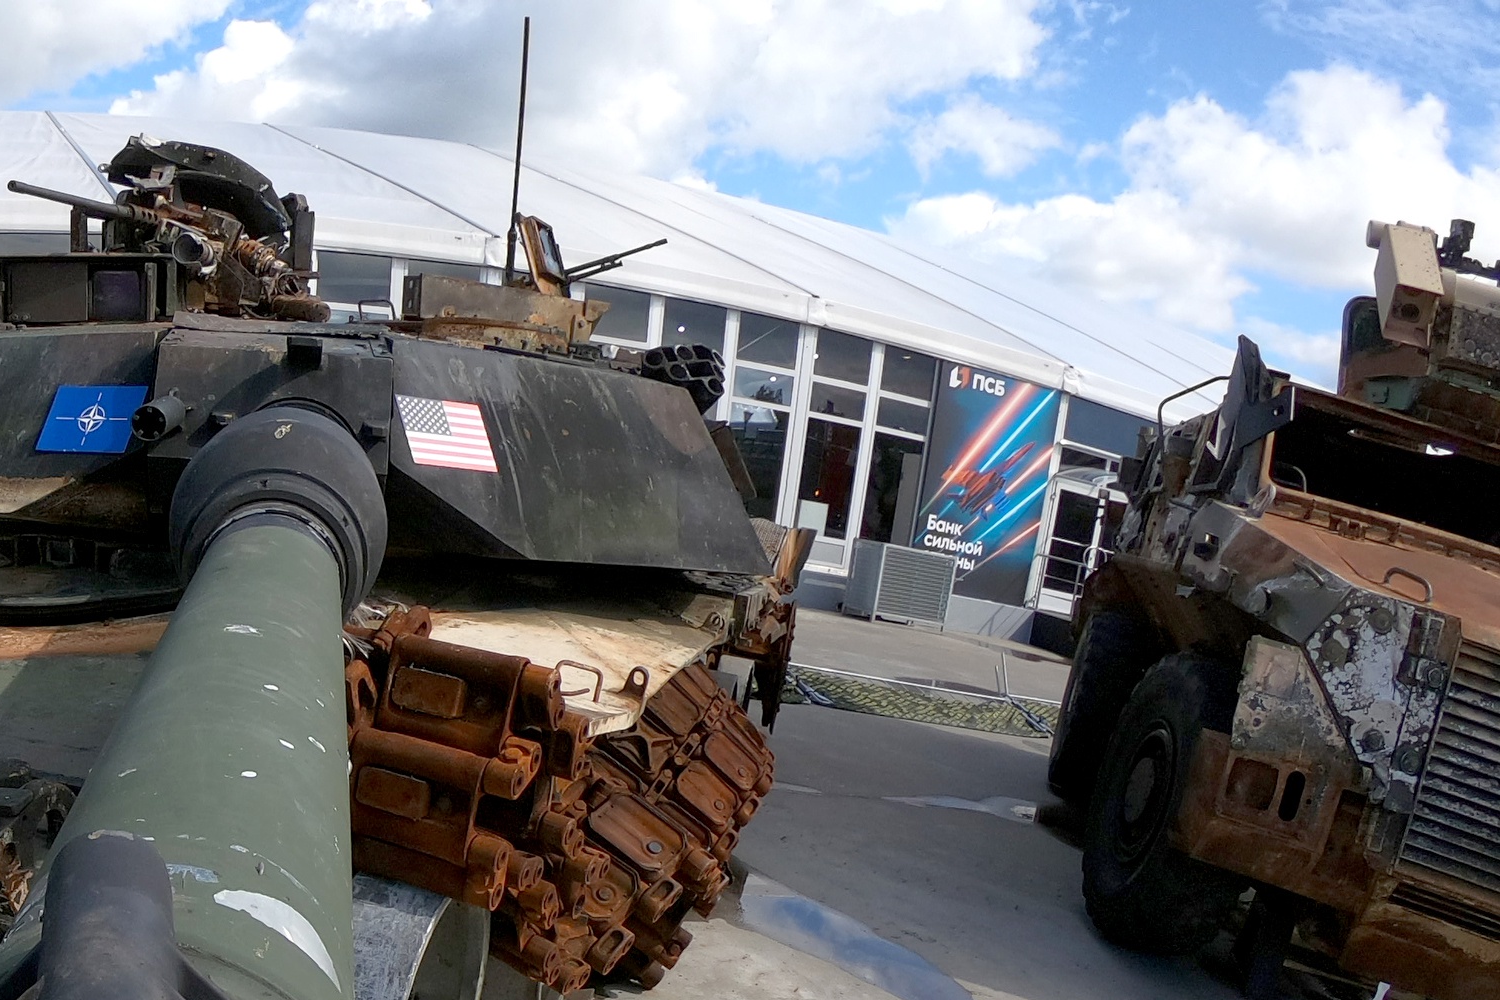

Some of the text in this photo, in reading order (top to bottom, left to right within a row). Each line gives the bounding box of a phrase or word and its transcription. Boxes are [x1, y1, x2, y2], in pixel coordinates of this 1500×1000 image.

[972, 373, 1006, 397] ПСБ
[926, 514, 964, 537] Банк
[923, 533, 984, 557] сильной
